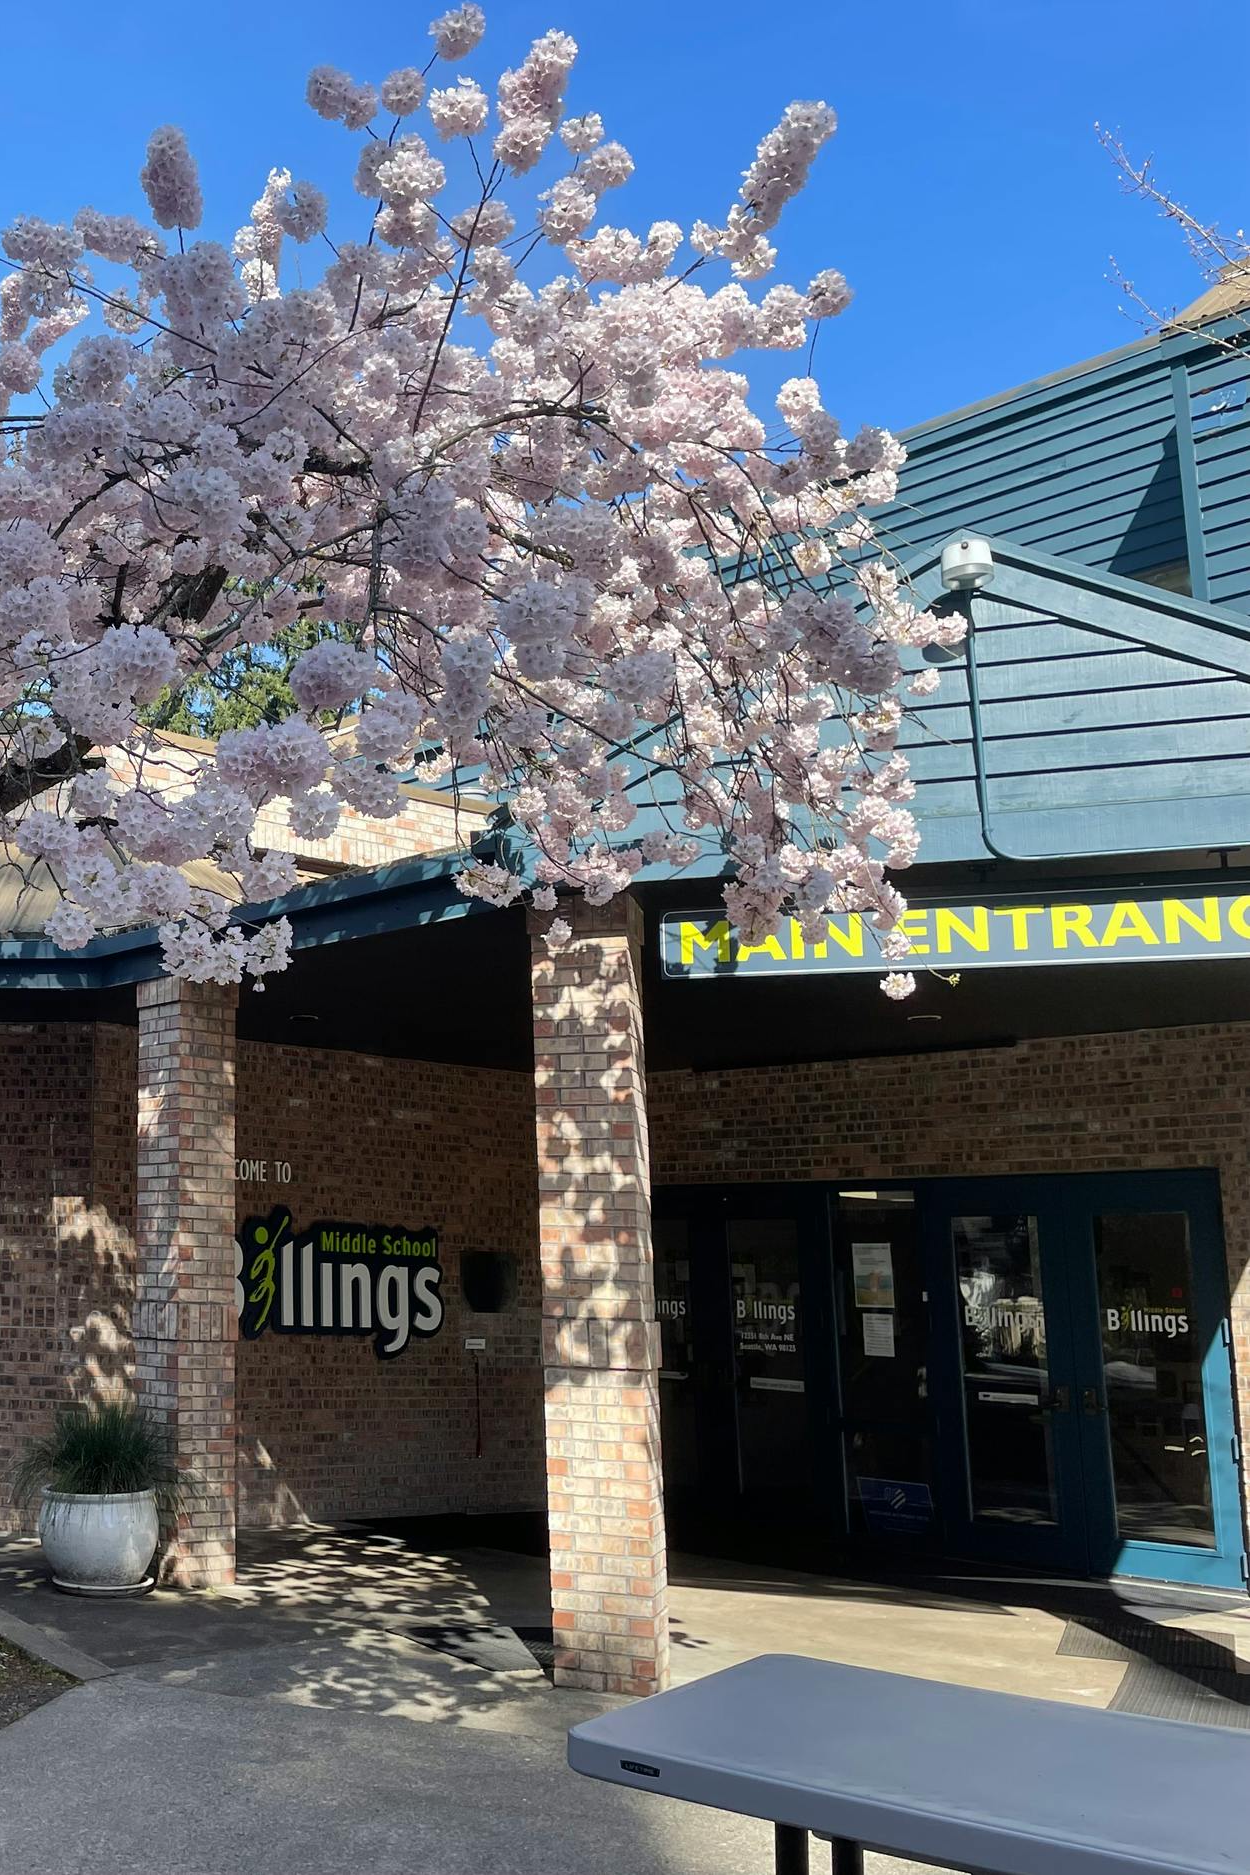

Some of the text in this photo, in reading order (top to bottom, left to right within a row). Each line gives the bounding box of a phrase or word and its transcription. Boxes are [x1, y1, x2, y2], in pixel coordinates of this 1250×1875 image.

[680, 912, 863, 964] MAIN
[274, 1161, 291, 1183] TO
[322, 1231, 436, 1258] Middle School
[1107, 1305, 1189, 1338] Billings
[765, 1343, 777, 1351] WA
[783, 1333, 794, 1341] NE
